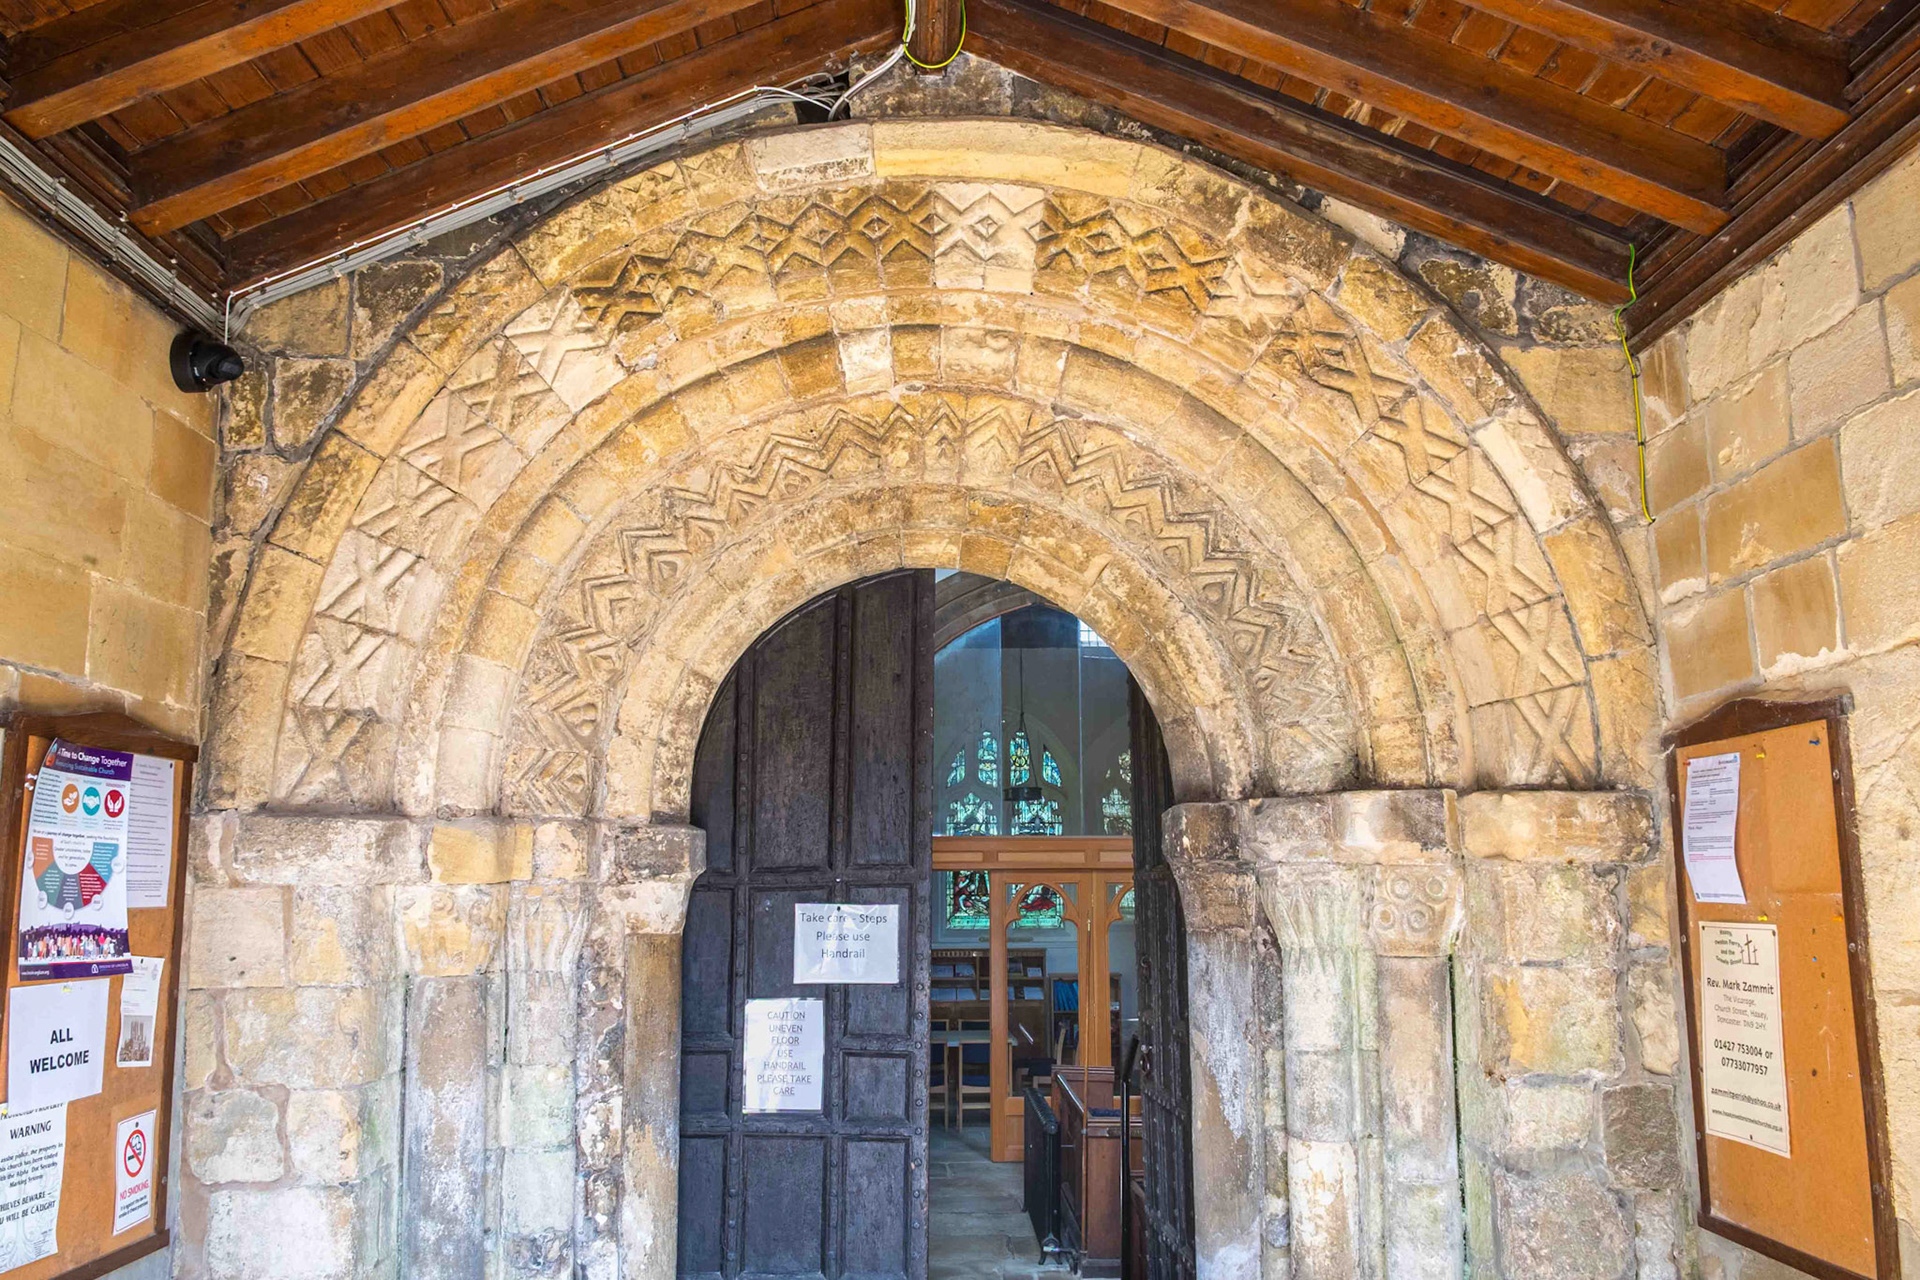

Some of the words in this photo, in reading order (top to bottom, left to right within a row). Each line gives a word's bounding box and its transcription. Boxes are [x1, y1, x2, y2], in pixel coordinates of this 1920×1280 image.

[61, 748, 70, 759] Time
[72, 752, 77, 760] to
[78, 752, 100, 765] Change
[101, 756, 128, 768] Together
[800, 912, 824, 922] Take
[859, 914, 888, 925] Steps
[816, 931, 849, 941] Please
[853, 933, 870, 941] use
[821, 948, 865, 958] Handrail
[1707, 978, 1720, 988] Rev.
[1722, 979, 1740, 991] Mark
[1742, 982, 1774, 995] Zammit
[1714, 1004, 1731, 1013] Church
[767, 1011, 806, 1020] CAUTION
[769, 1025, 803, 1034] UNEVEN
[50, 1028, 73, 1044] ALL
[772, 1036, 800, 1045] FLOOR
[777, 1050, 793, 1058] USE
[1714, 1039, 1735, 1052] 01427
[1737, 1043, 1763, 1058] 753004
[1765, 1050, 1773, 1059] or
[30, 1050, 89, 1074] WELCOME
[764, 1062, 806, 1070] HANDRAIL
[1721, 1057, 1768, 1076] 07733077957
[757, 1074, 788, 1083] PLEASE
[791, 1074, 812, 1083] TAKE
[773, 1087, 795, 1096] CARE
[10, 1120, 52, 1140] WARNING
[7, 1162, 22, 1170] church
[120, 1190, 127, 1200] NO
[128, 1179, 149, 1197] SMOKING
[0, 1199, 20, 1212] HIEVES
[22, 1191, 45, 1205] BEWARE
[6, 1212, 19, 1222] WILL
[21, 1208, 28, 1218] BE
[31, 1200, 56, 1214] CAUGHT
